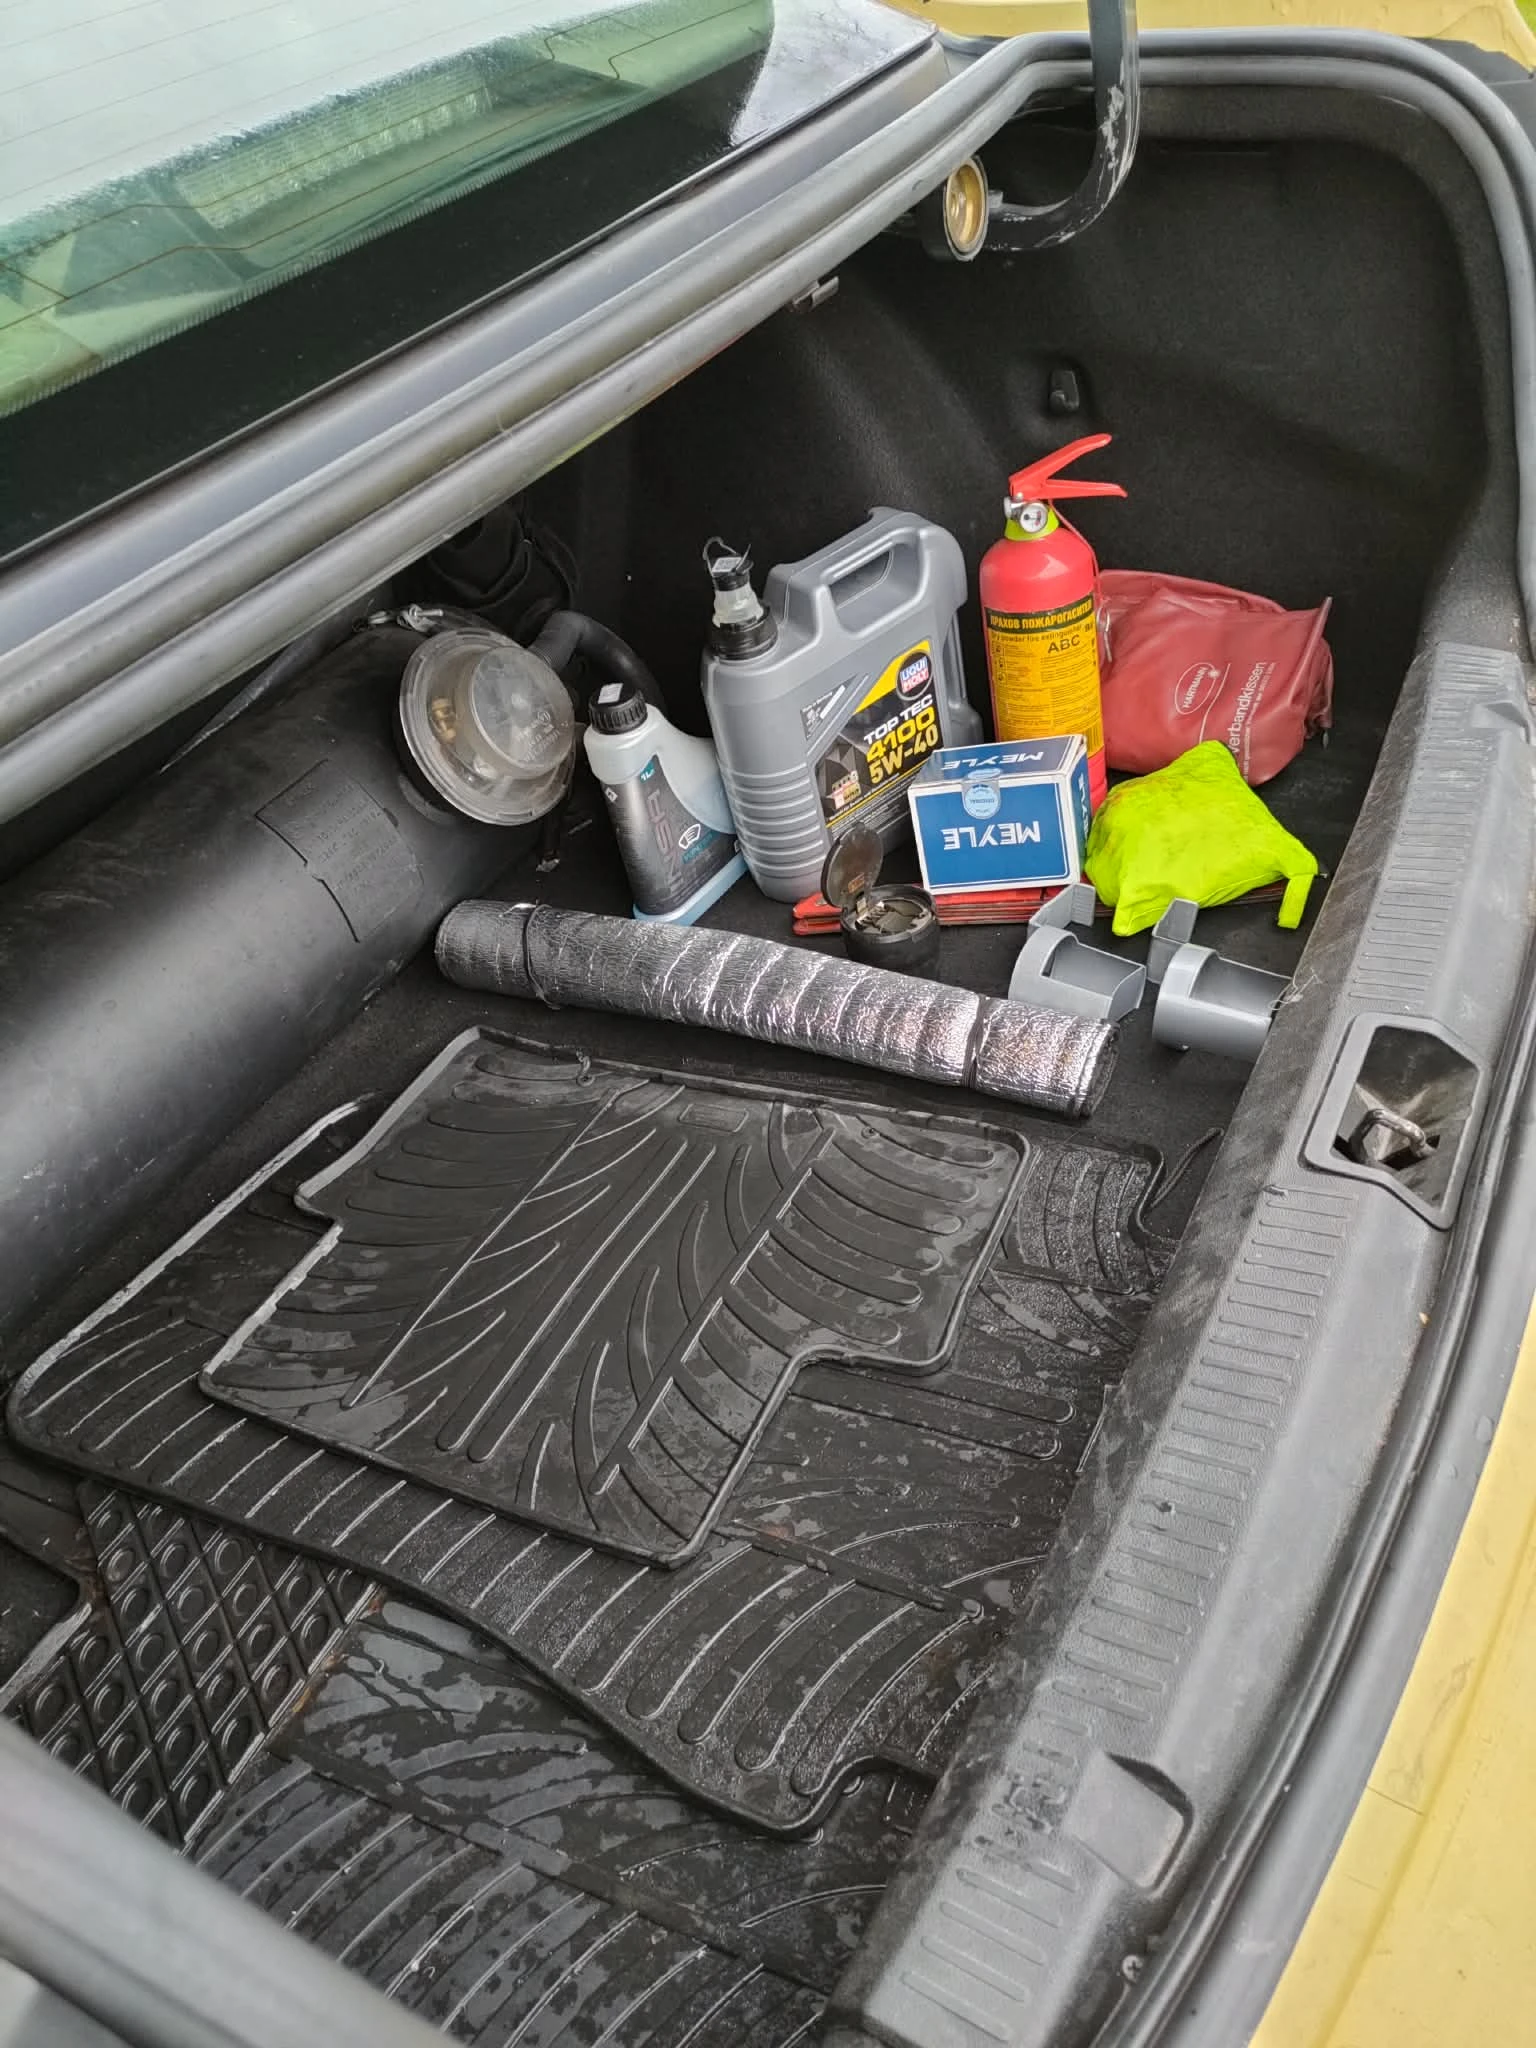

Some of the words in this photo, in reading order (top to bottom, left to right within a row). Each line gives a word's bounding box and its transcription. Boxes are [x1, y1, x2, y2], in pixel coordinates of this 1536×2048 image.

[1047, 634, 1081, 654] ABC
[900, 656, 928, 681] LIQUI
[901, 668, 929, 692] MOLY
[864, 718, 898, 744] TOP
[901, 694, 933, 721] TEC
[866, 707, 936, 762] 4100
[869, 725, 939, 784] 5W-40
[942, 751, 1044, 770] MEYLE
[942, 820, 1041, 851] MEYLE
